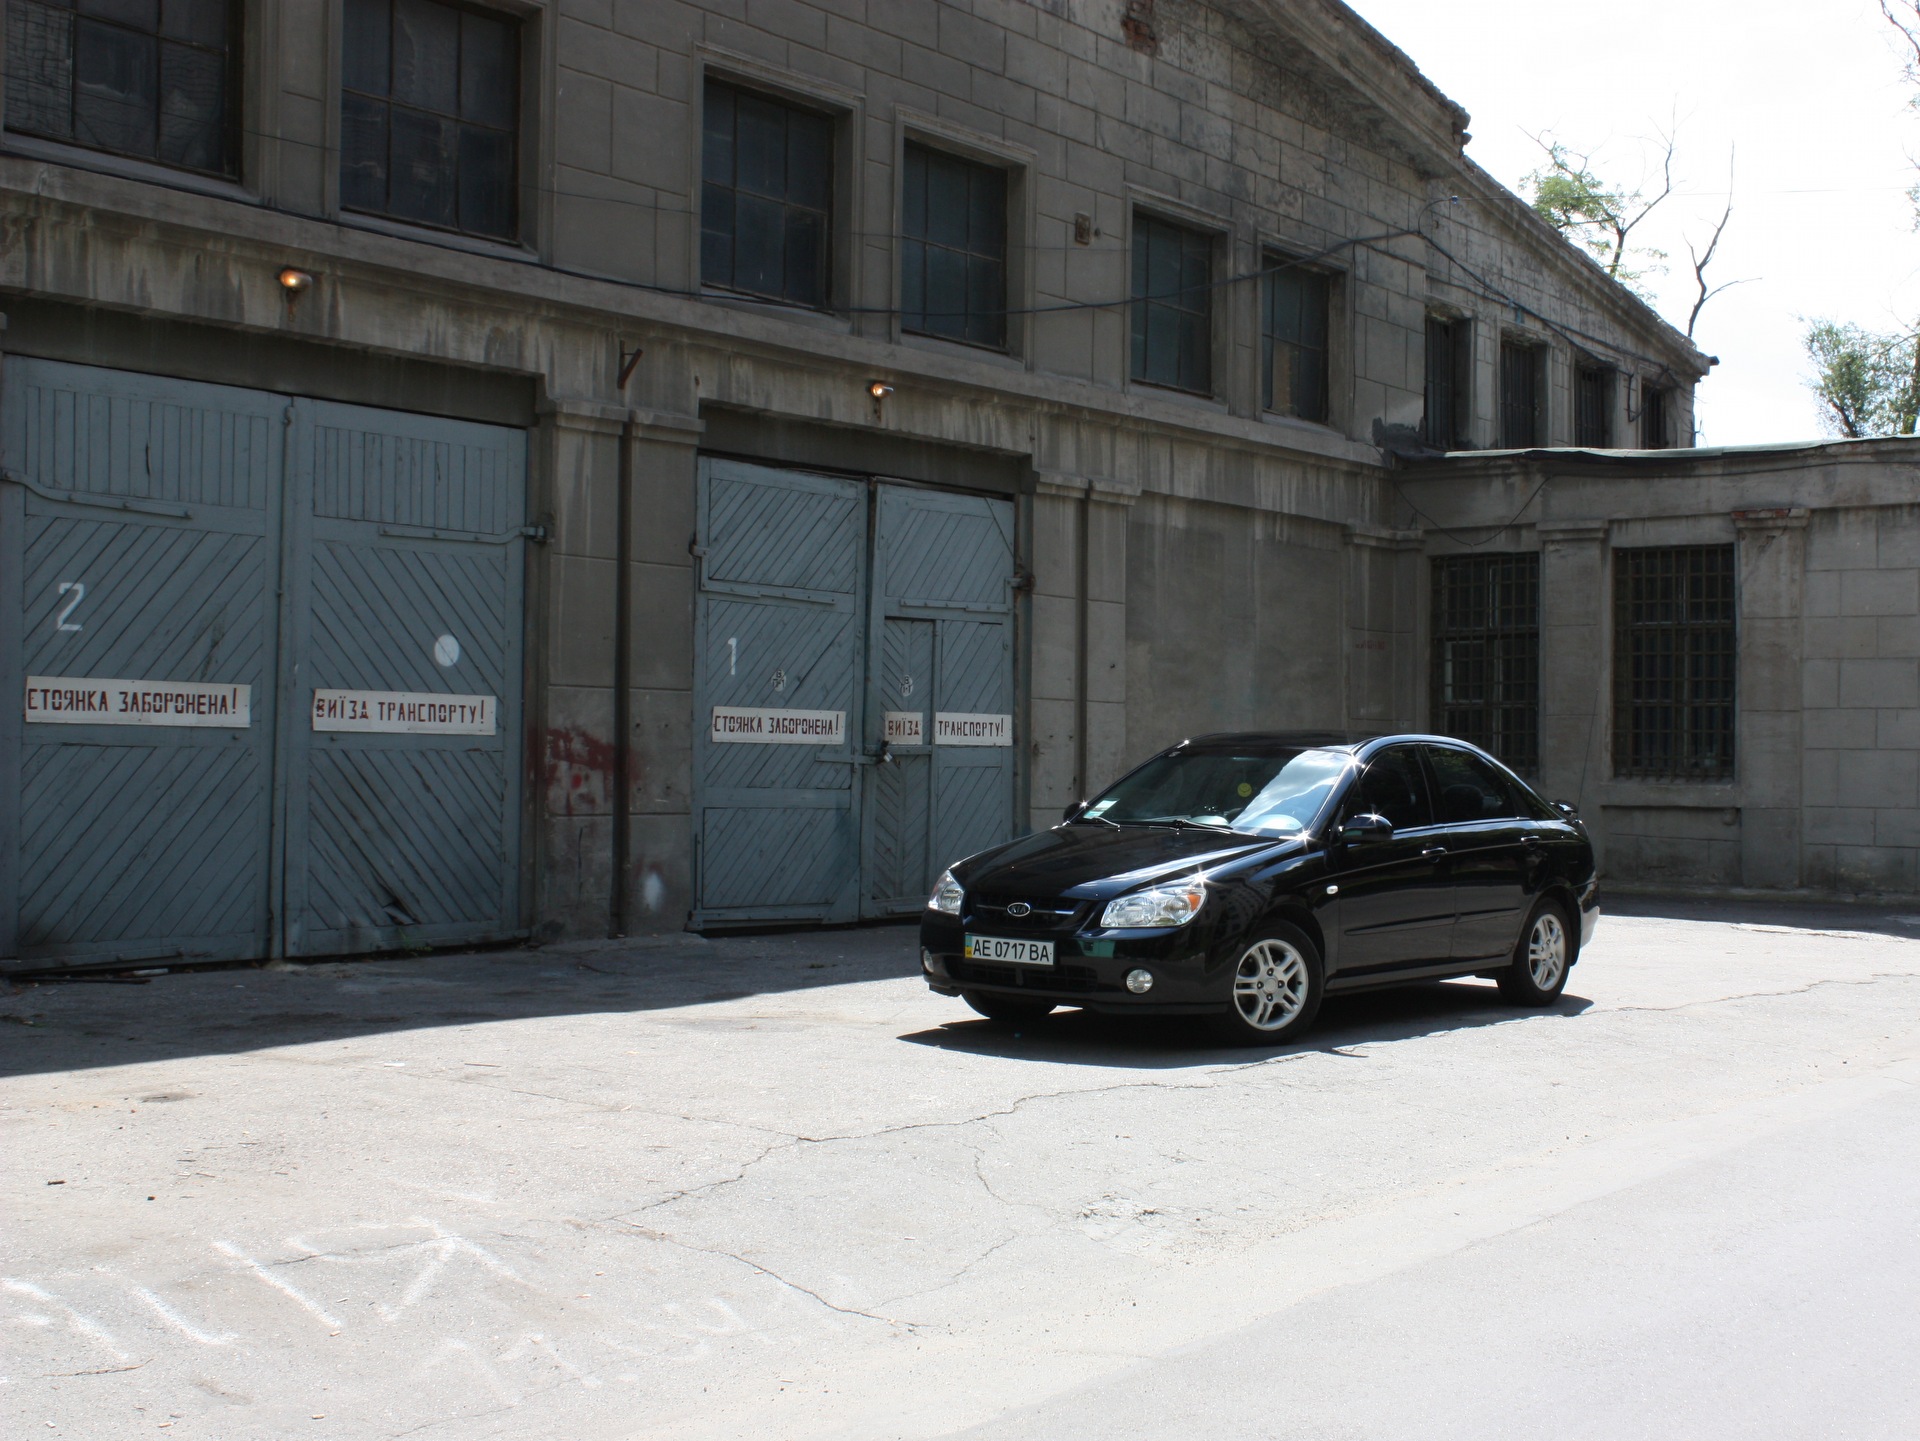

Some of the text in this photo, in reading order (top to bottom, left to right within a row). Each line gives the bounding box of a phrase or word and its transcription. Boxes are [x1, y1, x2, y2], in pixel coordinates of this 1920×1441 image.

[57, 582, 86, 632] 2
[727, 637, 738, 676] 1
[27, 687, 237, 715] СТОЯНКА ЗАБОРОНЕНА!
[315, 695, 485, 725] ВИЇЗД ТРАНСПОРТУ!
[713, 713, 839, 736] СТОЯНКА ЗАБОРОНЕНА!
[888, 717, 1004, 737] ВИЇЗД ТРАНСПОРТУ!
[973, 939, 1050, 962] AE 0717 BA
